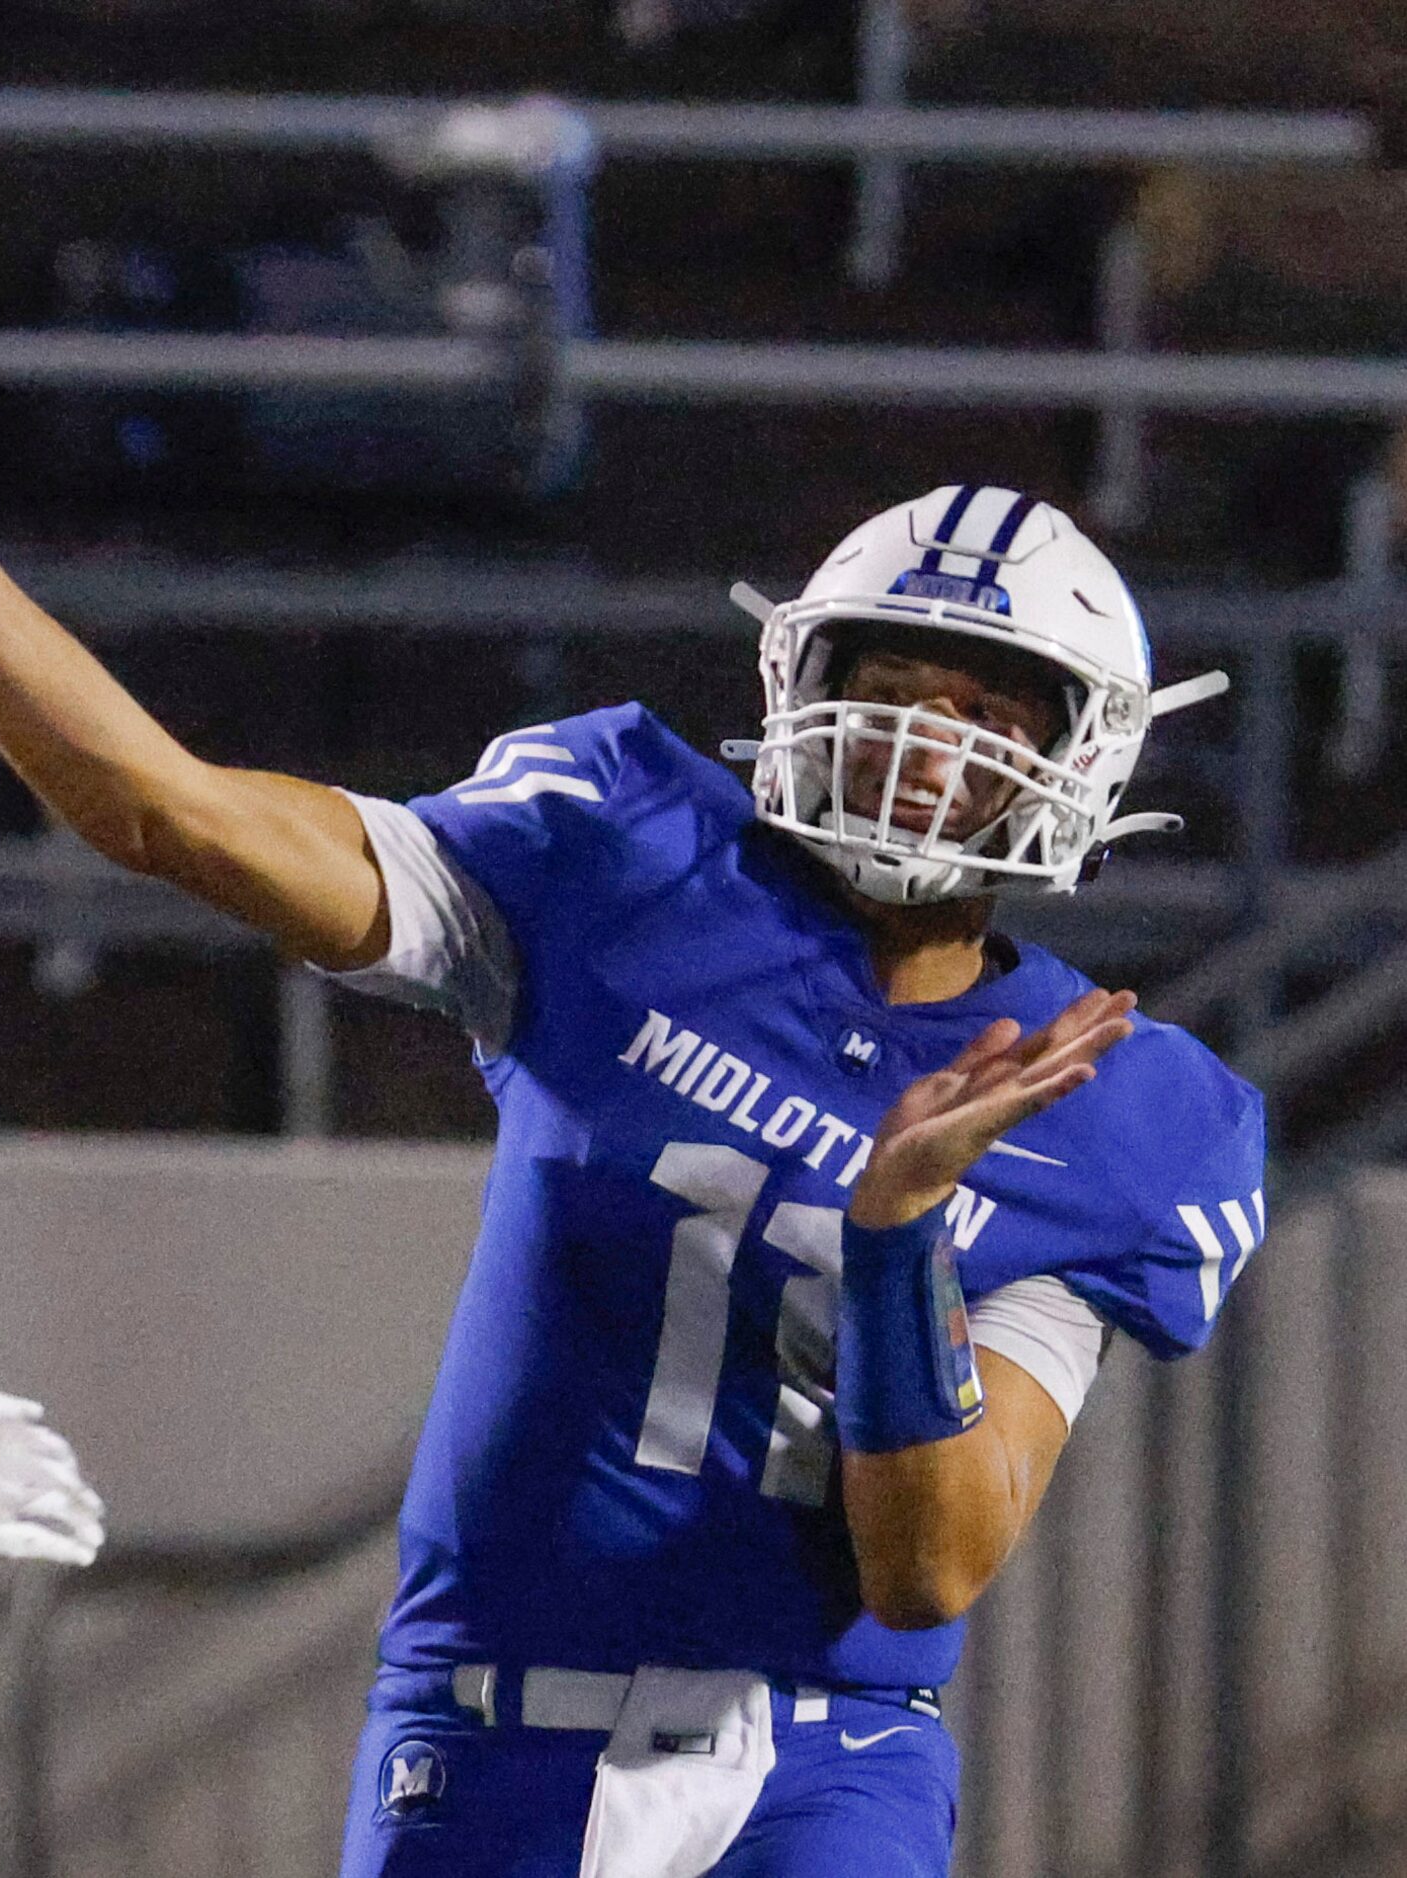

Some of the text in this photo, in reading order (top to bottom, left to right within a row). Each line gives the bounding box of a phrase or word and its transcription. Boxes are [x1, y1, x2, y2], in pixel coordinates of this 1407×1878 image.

[843, 1031, 876, 1061] M
[618, 1008, 998, 1251] MIDLOTN
[635, 1141, 844, 1506] 11
[389, 1757, 433, 1802] M
